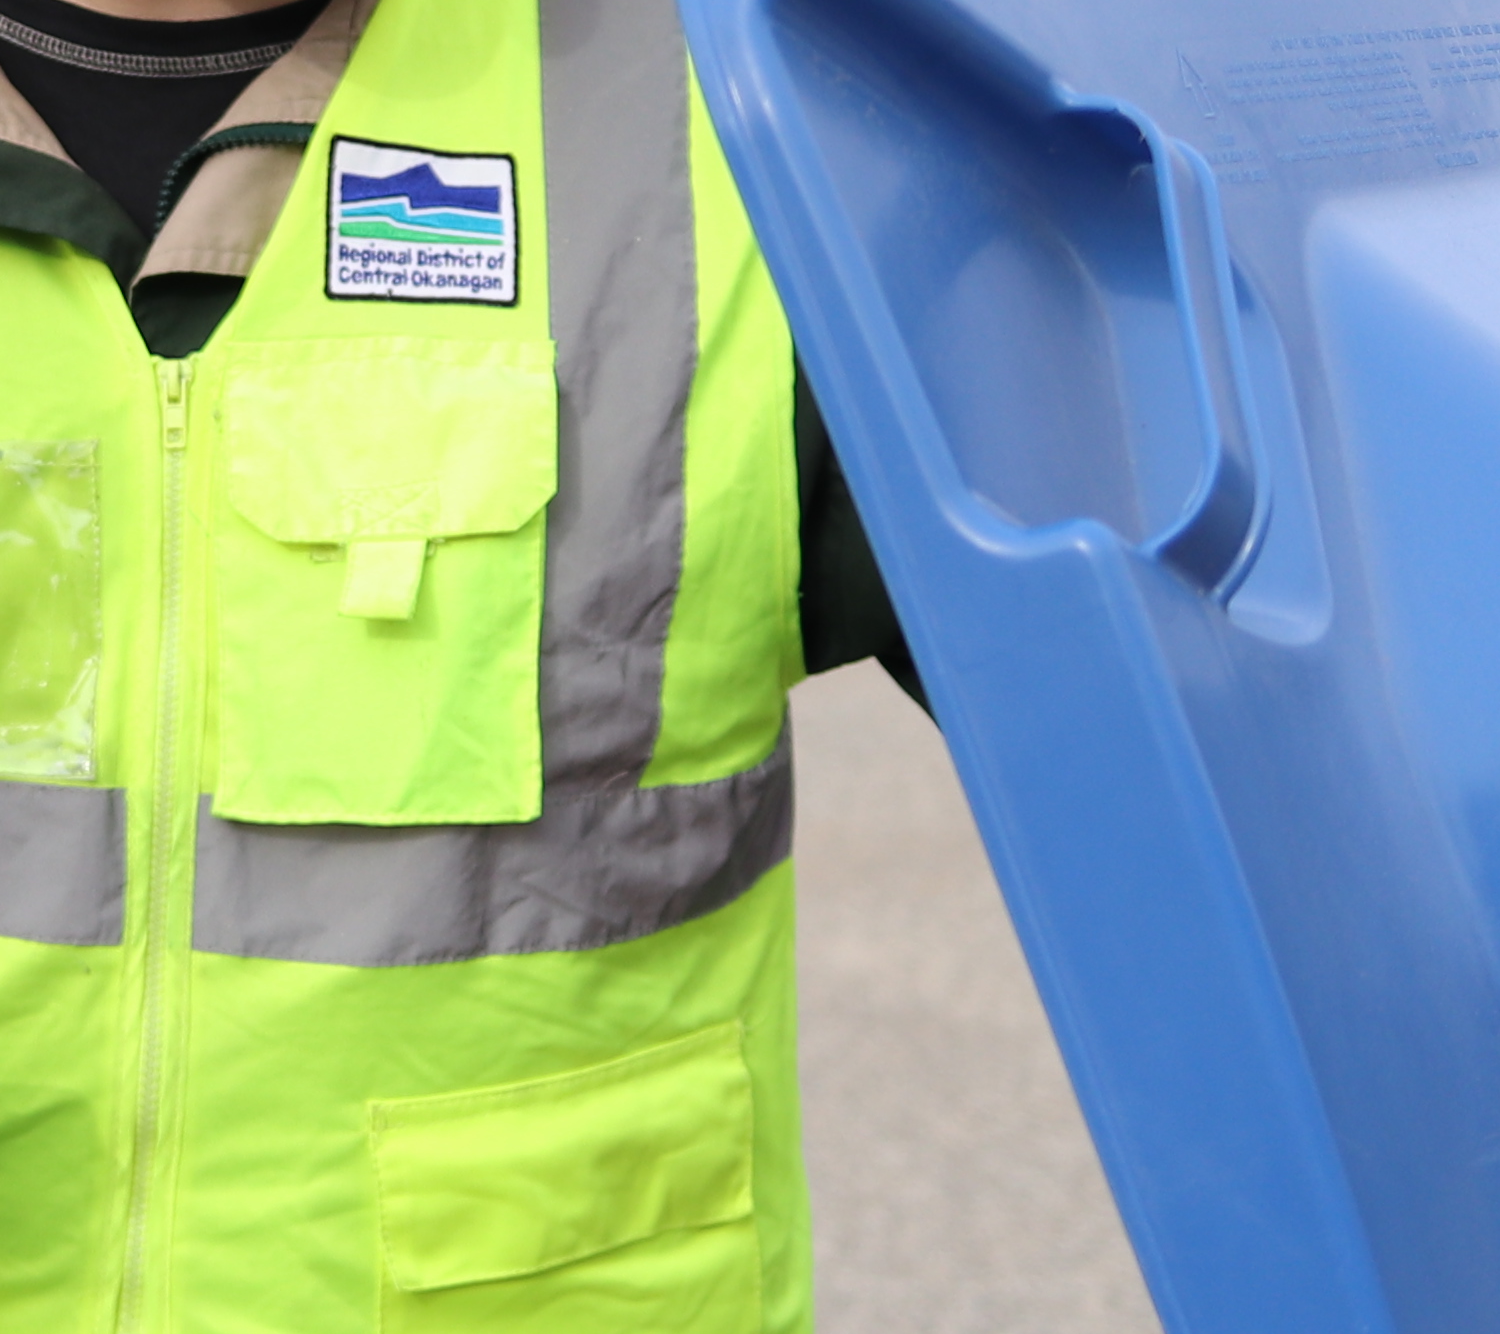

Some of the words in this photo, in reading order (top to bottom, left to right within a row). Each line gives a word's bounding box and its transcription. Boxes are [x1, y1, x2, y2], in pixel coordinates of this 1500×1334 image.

[339, 242, 412, 268] Regional
[417, 247, 483, 268] District
[487, 252, 505, 269] of
[339, 266, 408, 286] Central
[411, 270, 503, 293] Okanagan
